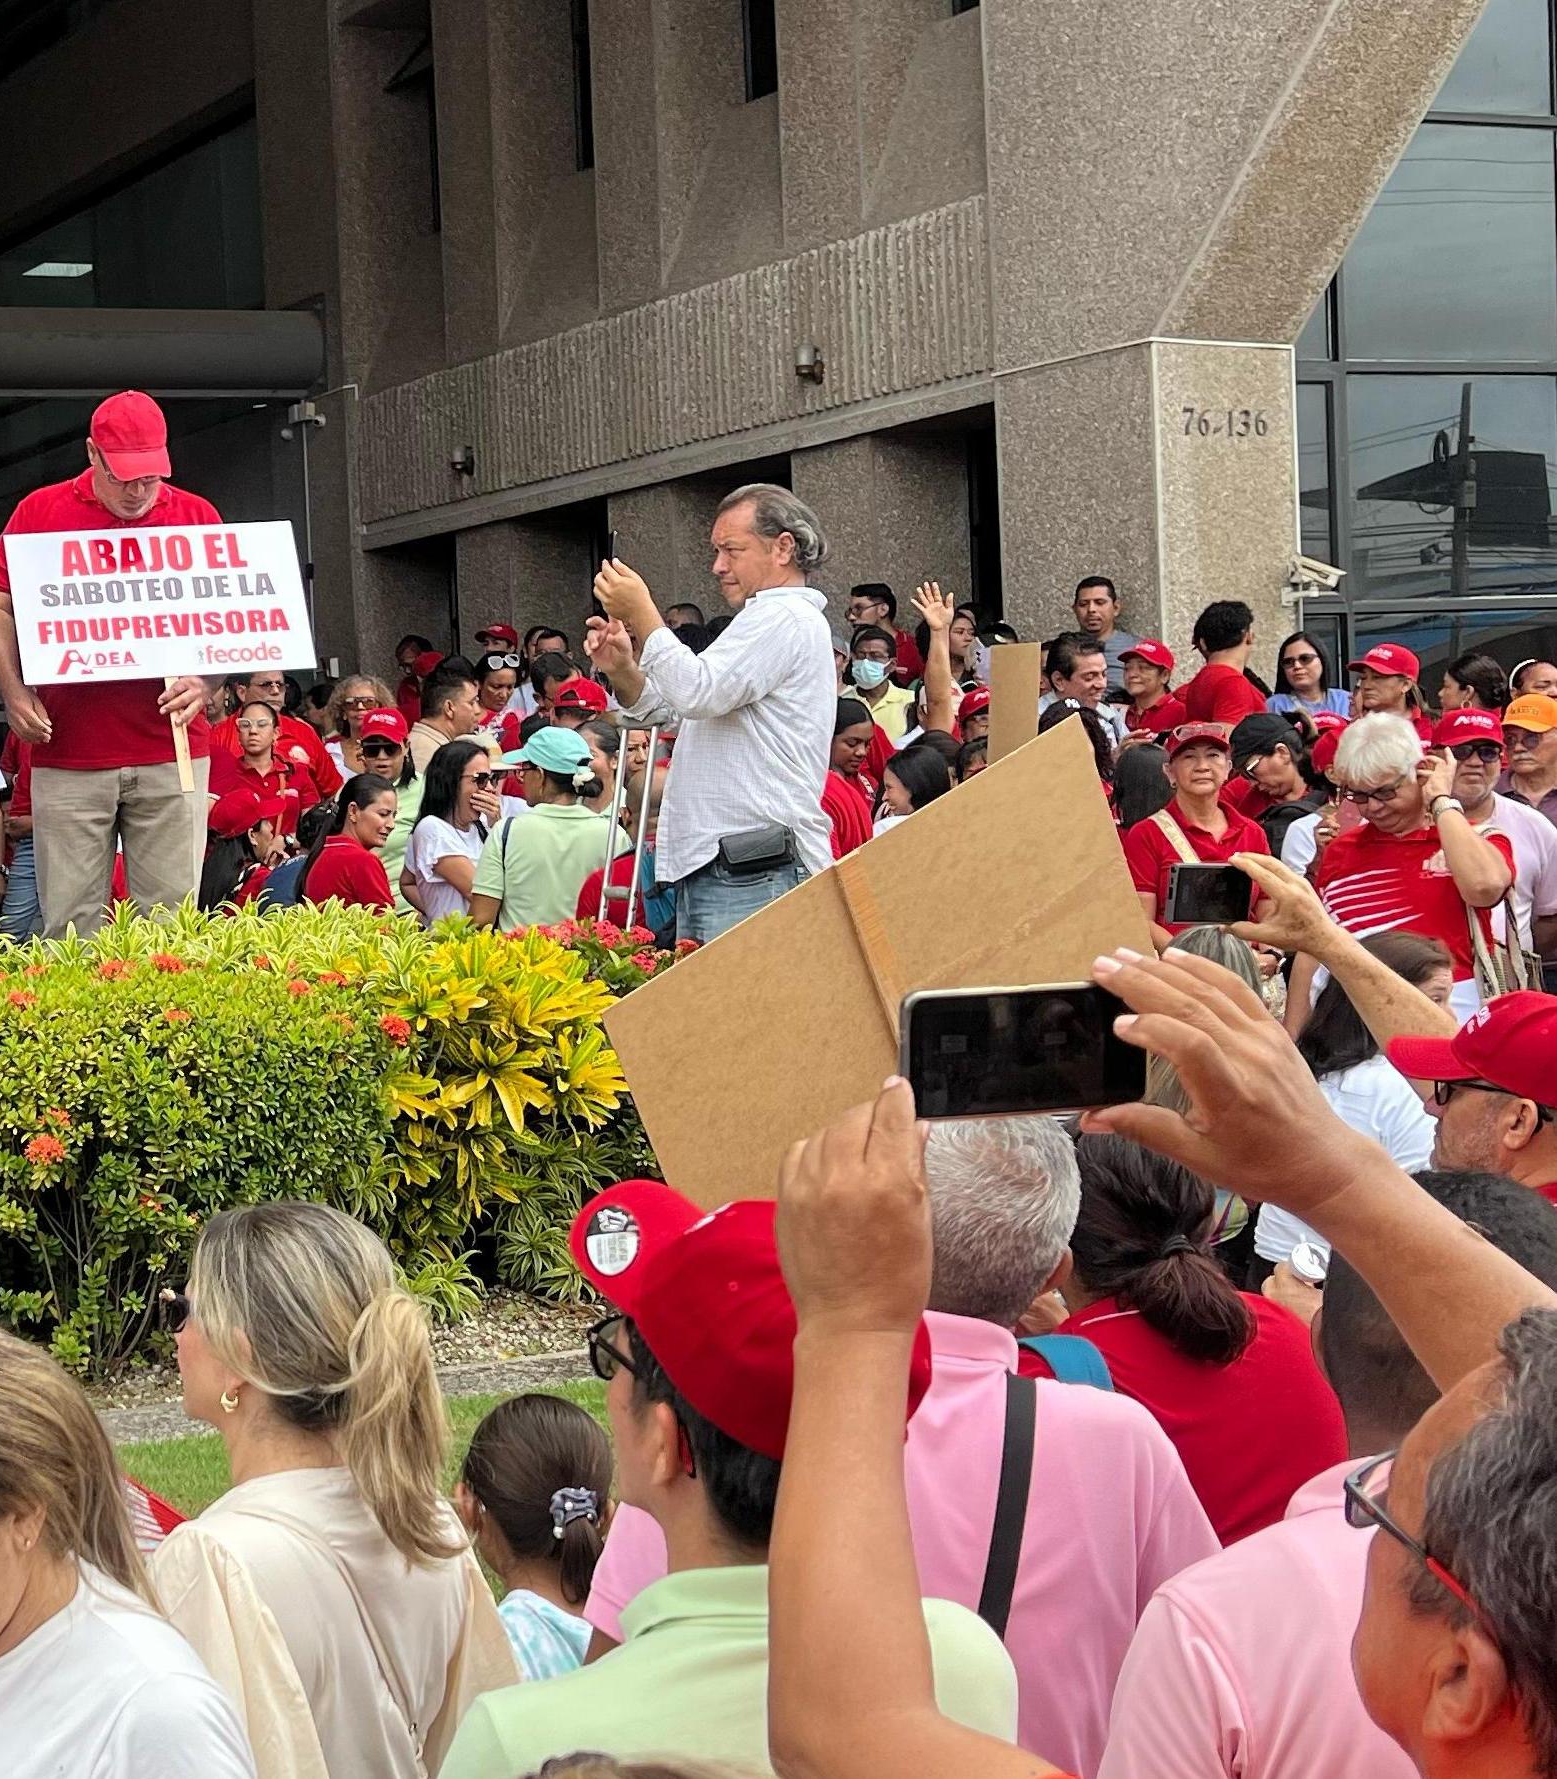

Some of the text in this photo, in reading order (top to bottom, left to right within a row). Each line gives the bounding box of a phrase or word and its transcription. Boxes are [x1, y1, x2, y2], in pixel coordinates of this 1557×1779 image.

[1181, 406, 1268, 437] 76-136
[61, 533, 248, 577] ABAJO EL
[39, 572, 276, 607] SABOTEO DE LA
[37, 608, 290, 645] FIDUPREVISORA
[206, 641, 283, 665] fecode
